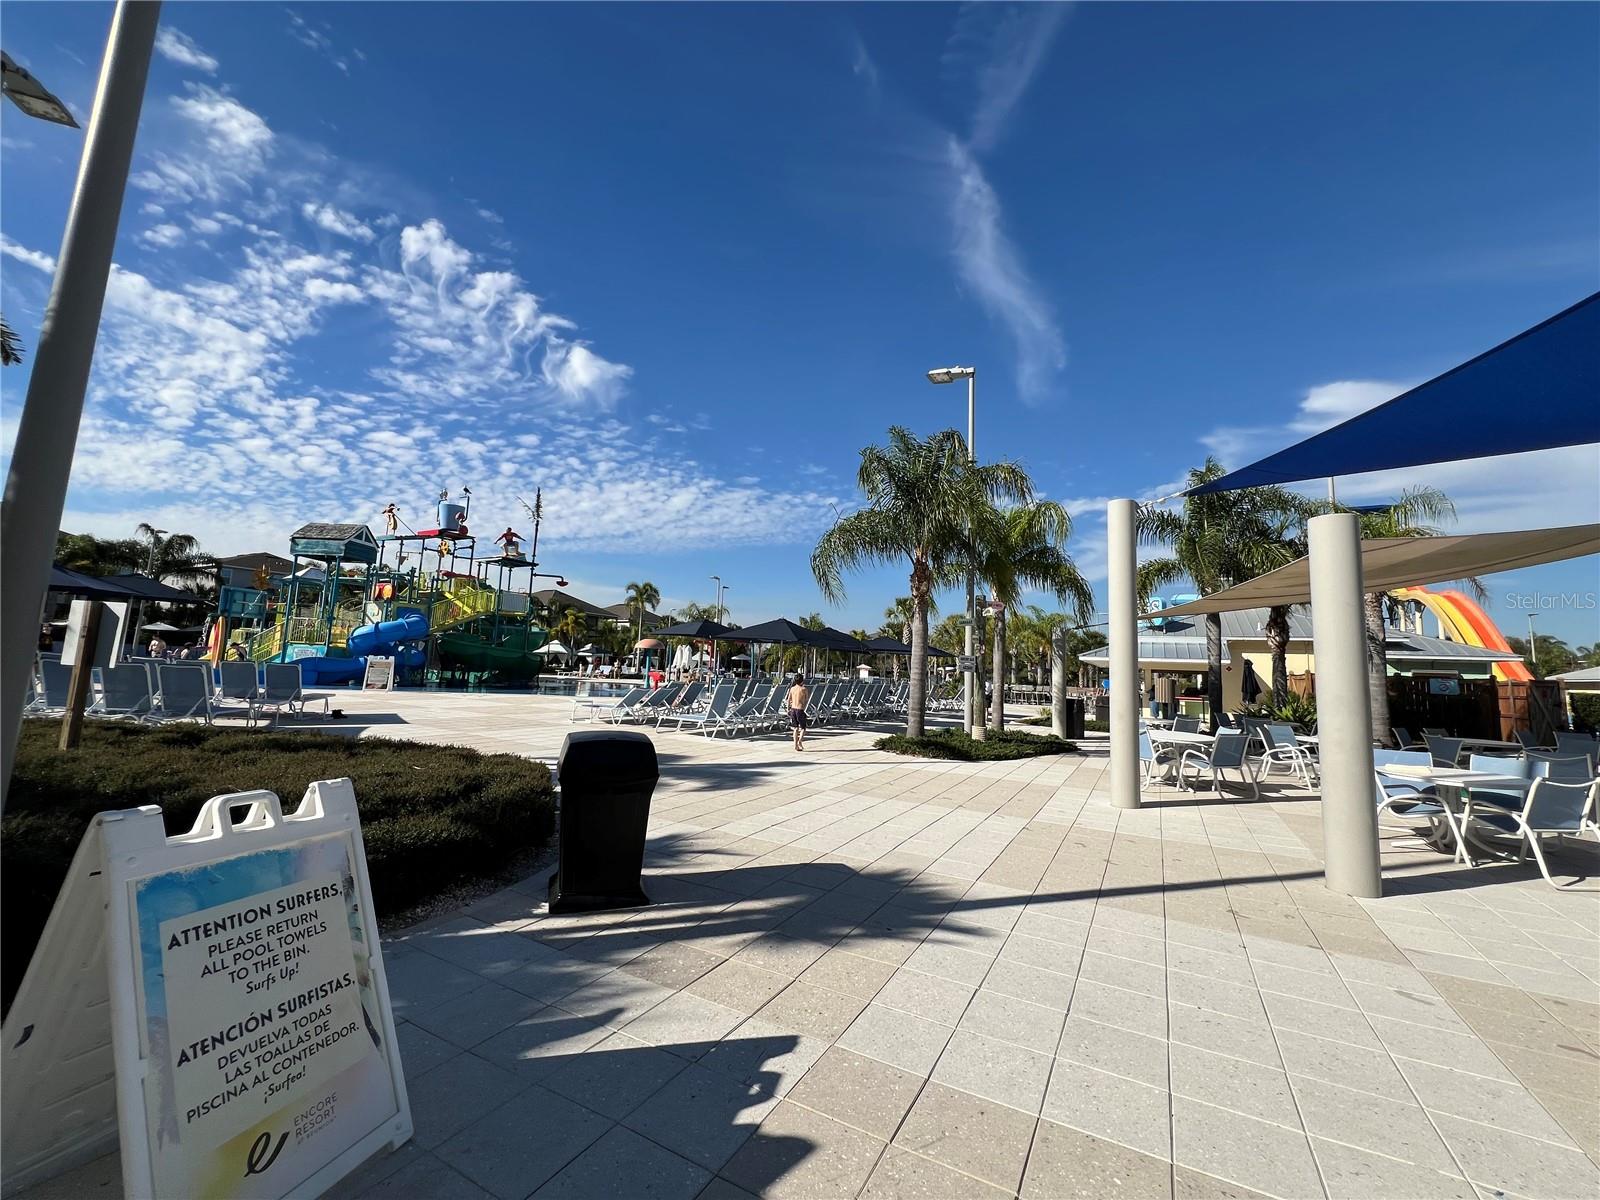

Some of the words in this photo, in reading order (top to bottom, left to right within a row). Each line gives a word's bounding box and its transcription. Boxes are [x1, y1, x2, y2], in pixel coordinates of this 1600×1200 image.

[167, 903, 272, 950] ATTENTION
[276, 883, 343, 914] SURFERS,
[208, 929, 263, 958] PLEASE
[267, 909, 319, 937] RETURN
[201, 958, 230, 978] ALL
[233, 941, 274, 966] POOL
[277, 921, 327, 948] TOWELS
[228, 966, 249, 984] TO
[252, 954, 281, 974] THE
[285, 944, 310, 962] BIN.
[245, 973, 276, 994] Surfs
[280, 962, 299, 981] Up!
[177, 1009, 273, 1068] ATENCIÓN
[217, 1026, 291, 1070] DEVUELVA
[292, 1004, 332, 1031] TODAS
[225, 1060, 252, 1084] LAS
[254, 1030, 311, 1068] TOALLAS
[314, 1019, 331, 1038] DE
[186, 1082, 249, 1124] PISCINA
[252, 1071, 270, 1088] AL
[272, 1021, 360, 1075] CONTENEDOR.
[264, 1065, 307, 1104] ¡Surfea!
[294, 1092, 337, 1127] ENCORE
[295, 1105, 336, 1139] RESORT
